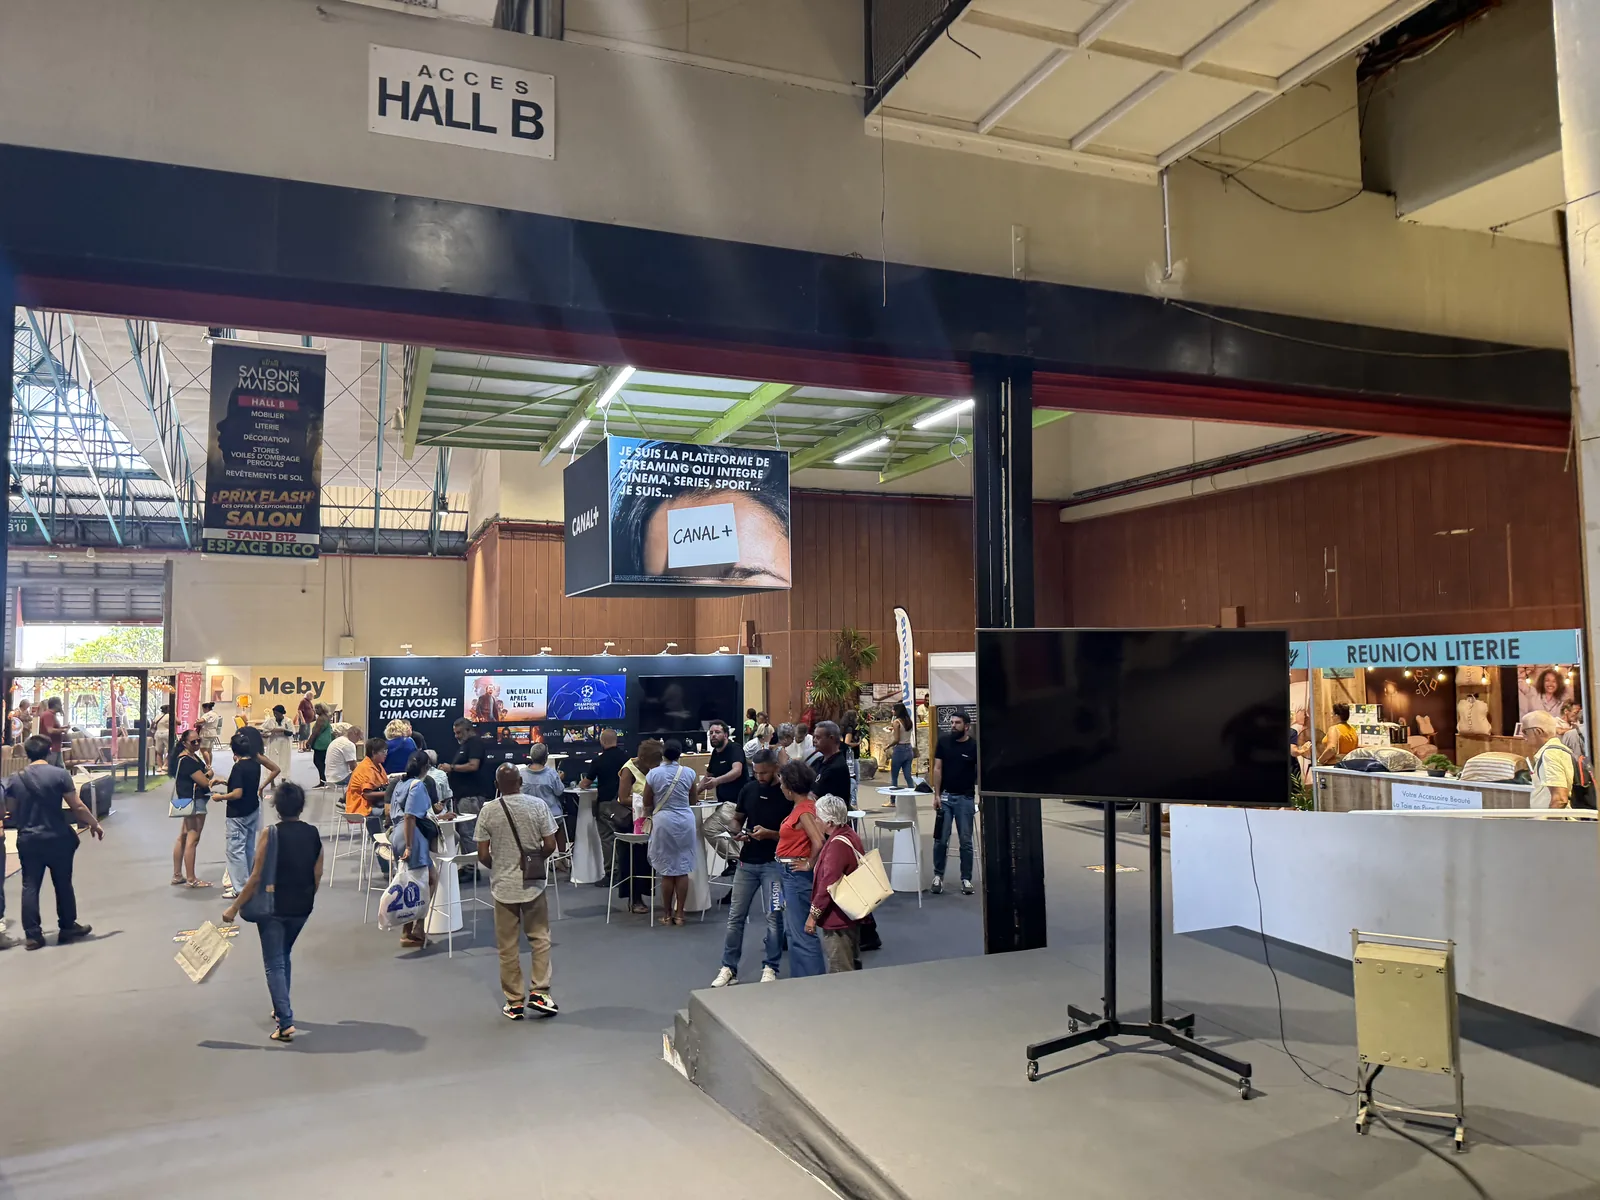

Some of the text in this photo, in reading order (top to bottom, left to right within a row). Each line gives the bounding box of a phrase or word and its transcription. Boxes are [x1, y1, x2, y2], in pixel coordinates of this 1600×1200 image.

[417, 64, 529, 95] ACCES
[378, 76, 545, 141] HALL B
[238, 365, 290, 381] SALON
[237, 377, 300, 394] MAISON
[251, 398, 285, 408] HALL B
[251, 411, 285, 419] MOBILIER
[254, 423, 280, 431] LITERIE
[243, 433, 290, 444] DÉCORATION
[252, 446, 280, 454] STORES
[230, 451, 301, 463] VOILES D'OMBRAGE
[618, 446, 770, 467] JE SUIS LA PLATEFORME DE
[246, 459, 285, 468] PERGOLAS
[619, 460, 764, 479] STREAMING QUI INTEGRE
[225, 469, 278, 480] REVÊTEMENTS
[619, 472, 761, 491] CINEMA, SERIES, SPORT...
[218, 490, 260, 502] PRIX
[619, 485, 673, 498] JE SUIS...
[225, 510, 303, 527] SALON
[571, 505, 600, 537] CANAL+
[227, 530, 297, 542] STAND B12
[206, 539, 315, 556] ESPACE DECO
[1347, 637, 1521, 664] REUNION LITERIE
[258, 676, 326, 699] Meby
[379, 676, 431, 687] CANAL+,
[379, 687, 439, 697] C'EST PLUS
[379, 698, 457, 708] QUE VOUS NE
[379, 709, 446, 719] L'IMAGINEZ
[1402, 791, 1417, 799] Votre
[387, 881, 420, 913] 20
[772, 880, 781, 911] MAISON
